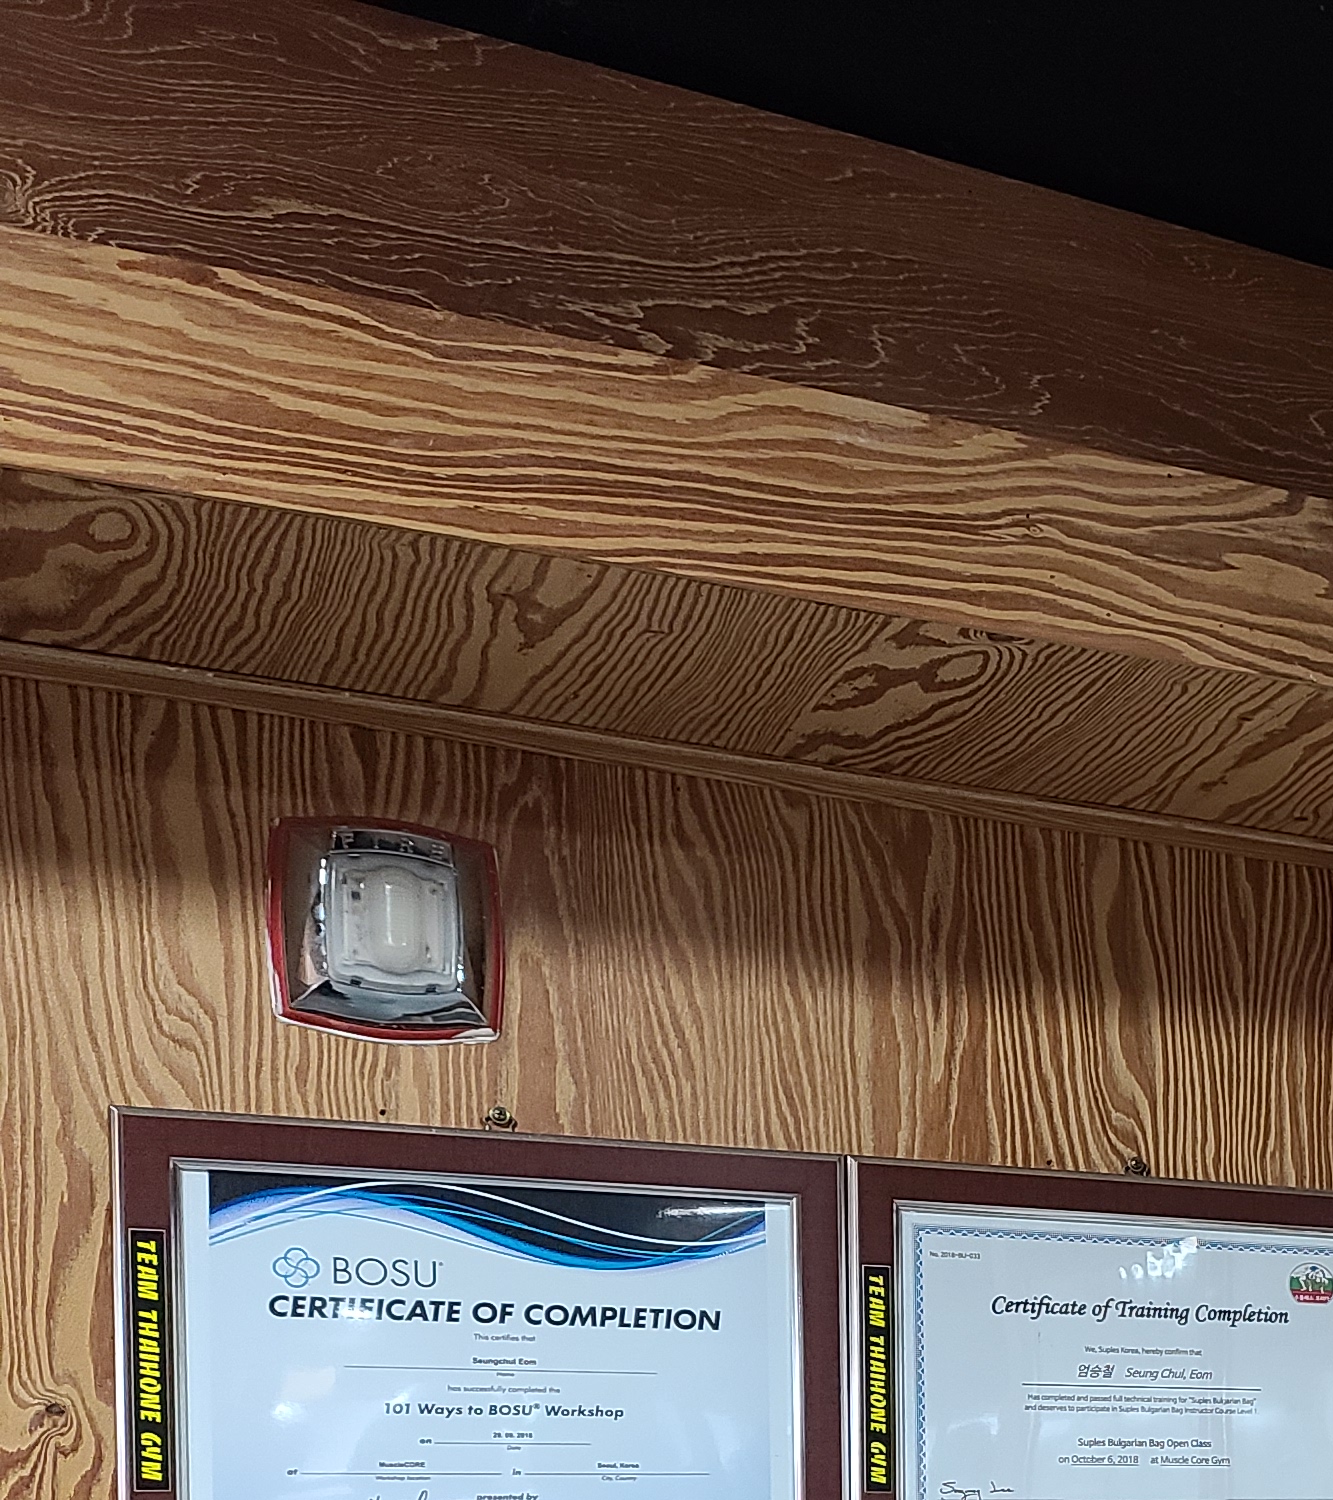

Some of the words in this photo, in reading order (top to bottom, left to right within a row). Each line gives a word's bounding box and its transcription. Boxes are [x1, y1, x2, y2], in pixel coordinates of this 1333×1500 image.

[136, 1240, 158, 1300] TEAM
[471, 1301, 515, 1324] OF
[523, 1303, 721, 1330] COMPLETION
[868, 1275, 885, 1327] TEAM
[991, 1295, 1087, 1320] Certificate
[1091, 1299, 1112, 1325] of
[1115, 1300, 1190, 1325] Training
[1194, 1304, 1289, 1328] Completion
[137, 1309, 161, 1422] THAIHONE
[869, 1335, 886, 1433] THAIHONE
[1124, 1367, 1159, 1381] Seung
[1188, 1368, 1213, 1380] Eom
[384, 1402, 410, 1414] 101
[417, 1403, 463, 1419] Ways
[467, 1405, 483, 1415] to
[544, 1404, 624, 1421] Workshop
[140, 1431, 162, 1481] GYM
[869, 1441, 887, 1483] GYM
